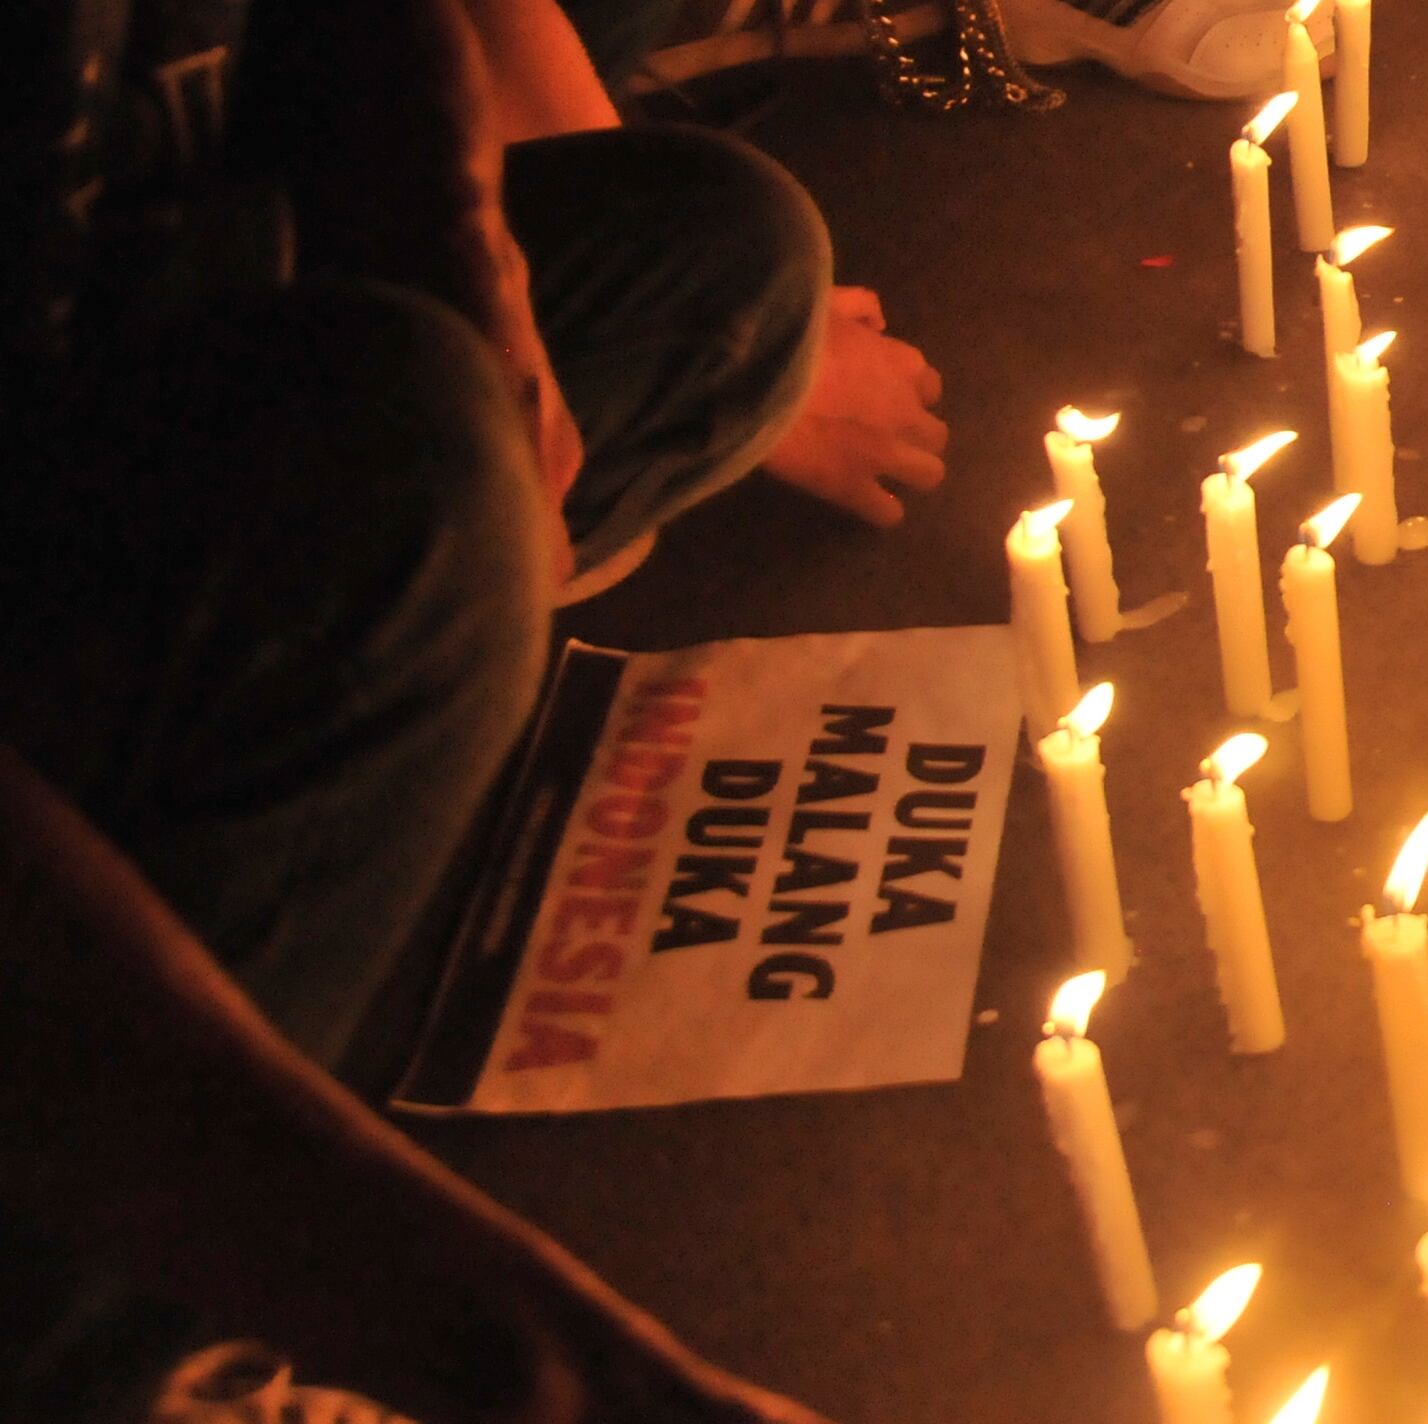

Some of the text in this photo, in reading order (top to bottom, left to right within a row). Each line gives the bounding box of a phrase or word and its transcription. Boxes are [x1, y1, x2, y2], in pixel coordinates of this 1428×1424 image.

[505, 676, 708, 1072] INDONESIA
[650, 760, 783, 954] DUKA
[747, 705, 896, 1001] MALANG
[870, 743, 986, 934] DUKA
